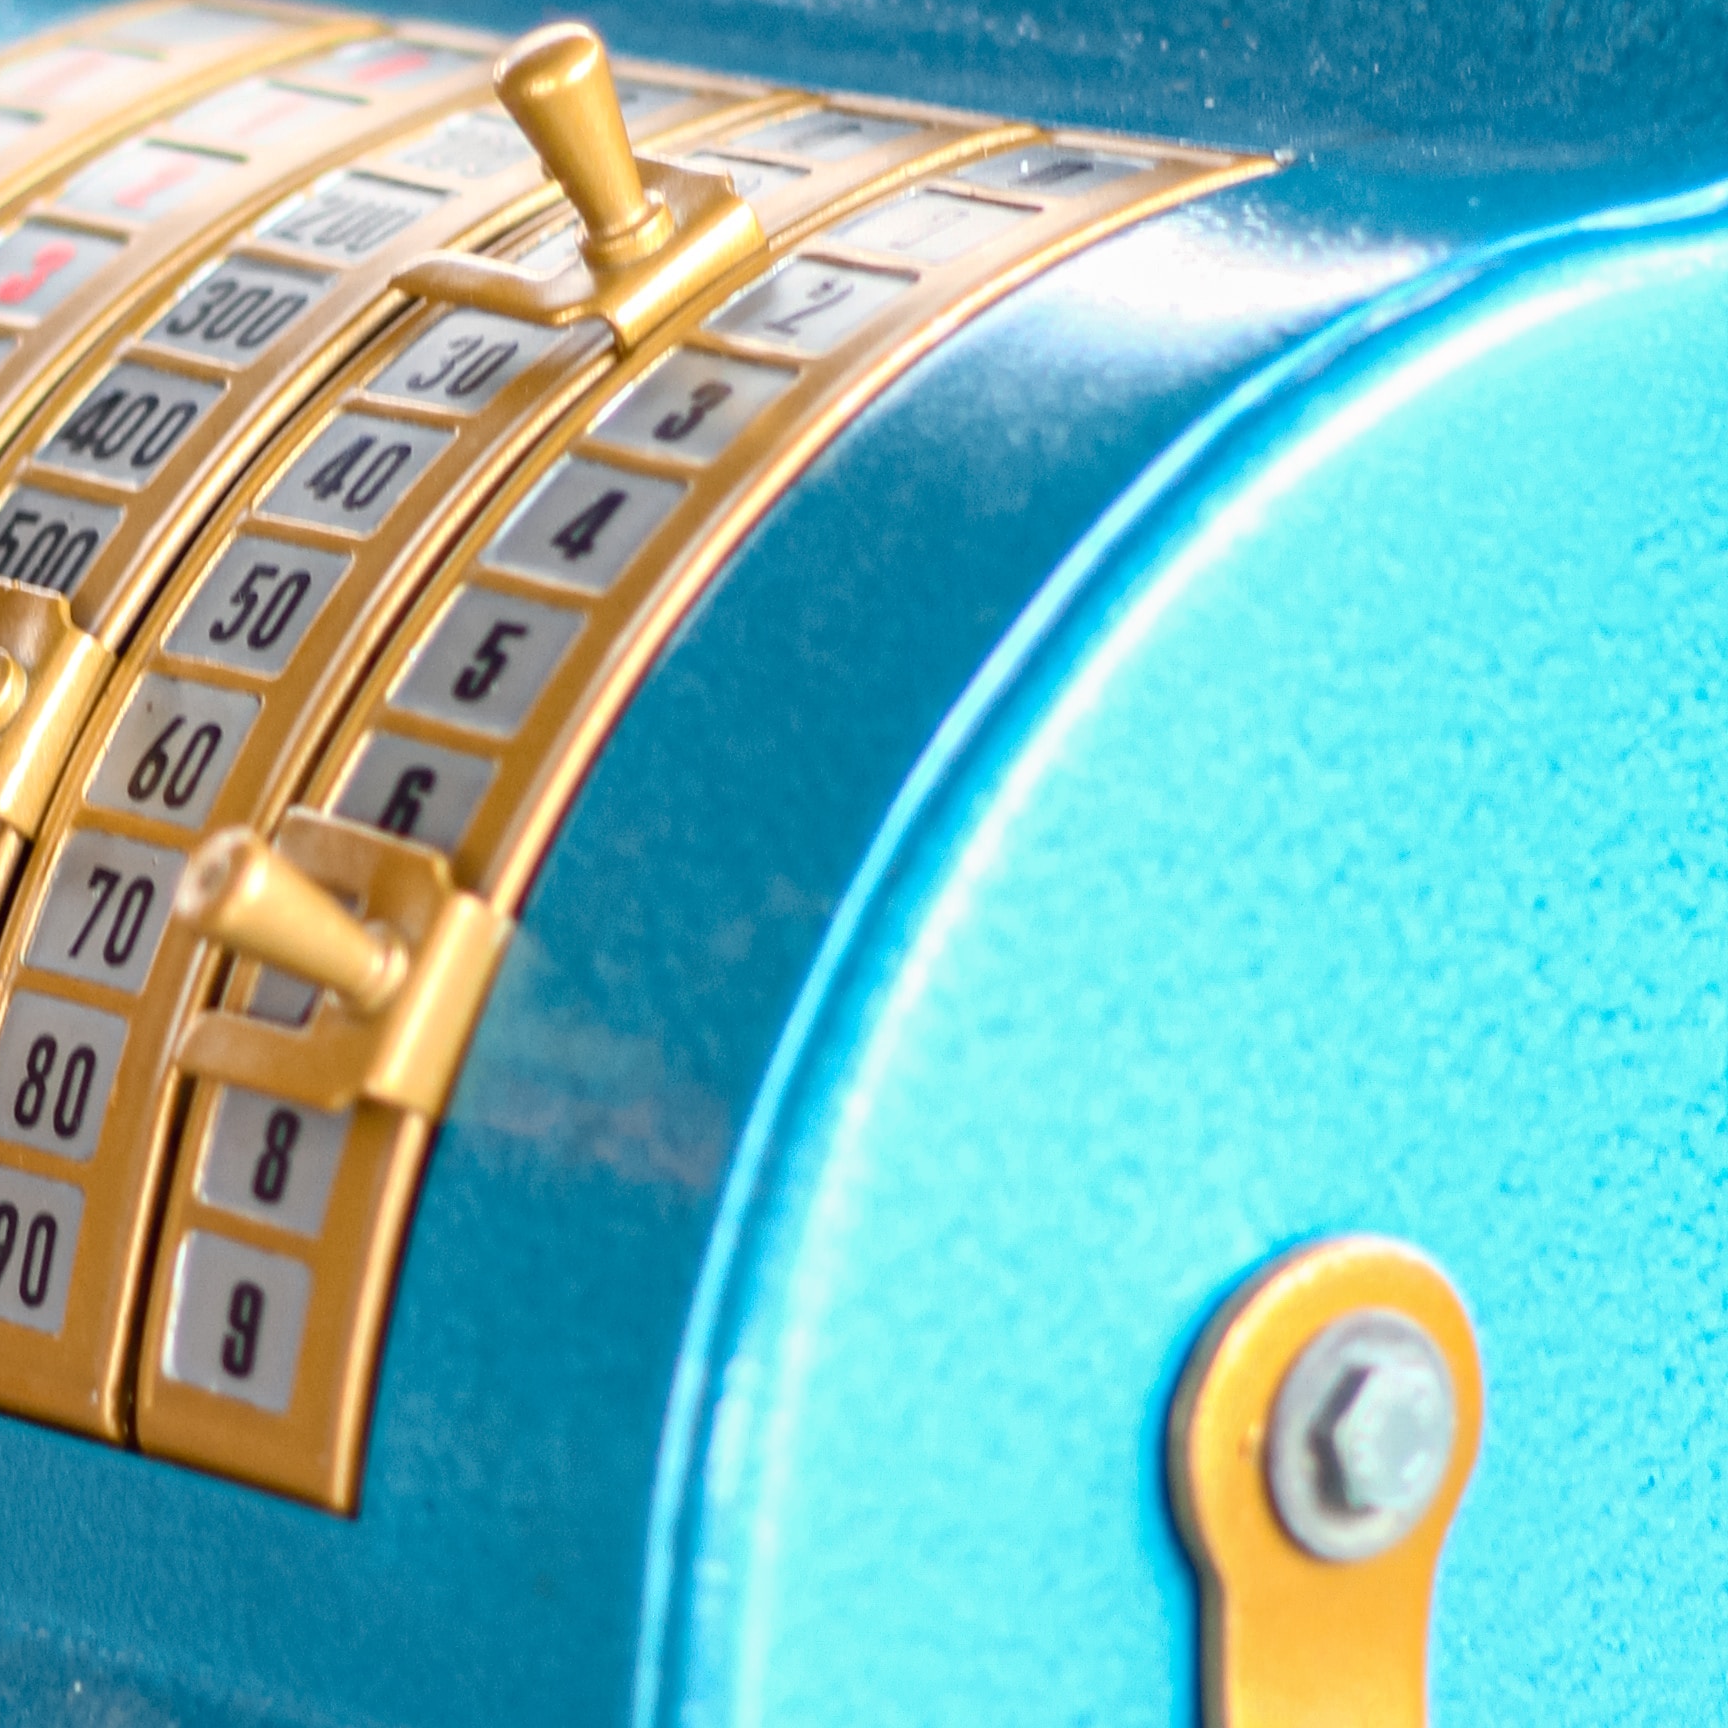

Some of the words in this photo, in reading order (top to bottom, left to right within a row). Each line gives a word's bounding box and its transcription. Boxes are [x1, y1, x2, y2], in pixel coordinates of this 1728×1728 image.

[165, 277, 310, 349] 300
[406, 334, 520, 399] 30
[59, 390, 200, 468] 400
[653, 377, 733, 442] 3
[303, 433, 413, 512] 40
[549, 488, 629, 562] 4
[207, 563, 312, 652] 50
[452, 618, 529, 702] 5
[126, 714, 223, 810] 60
[69, 866, 156, 968] 70
[12, 1033, 98, 1140] 80
[251, 1108, 303, 1205] 8
[219, 1281, 267, 1380] 9
